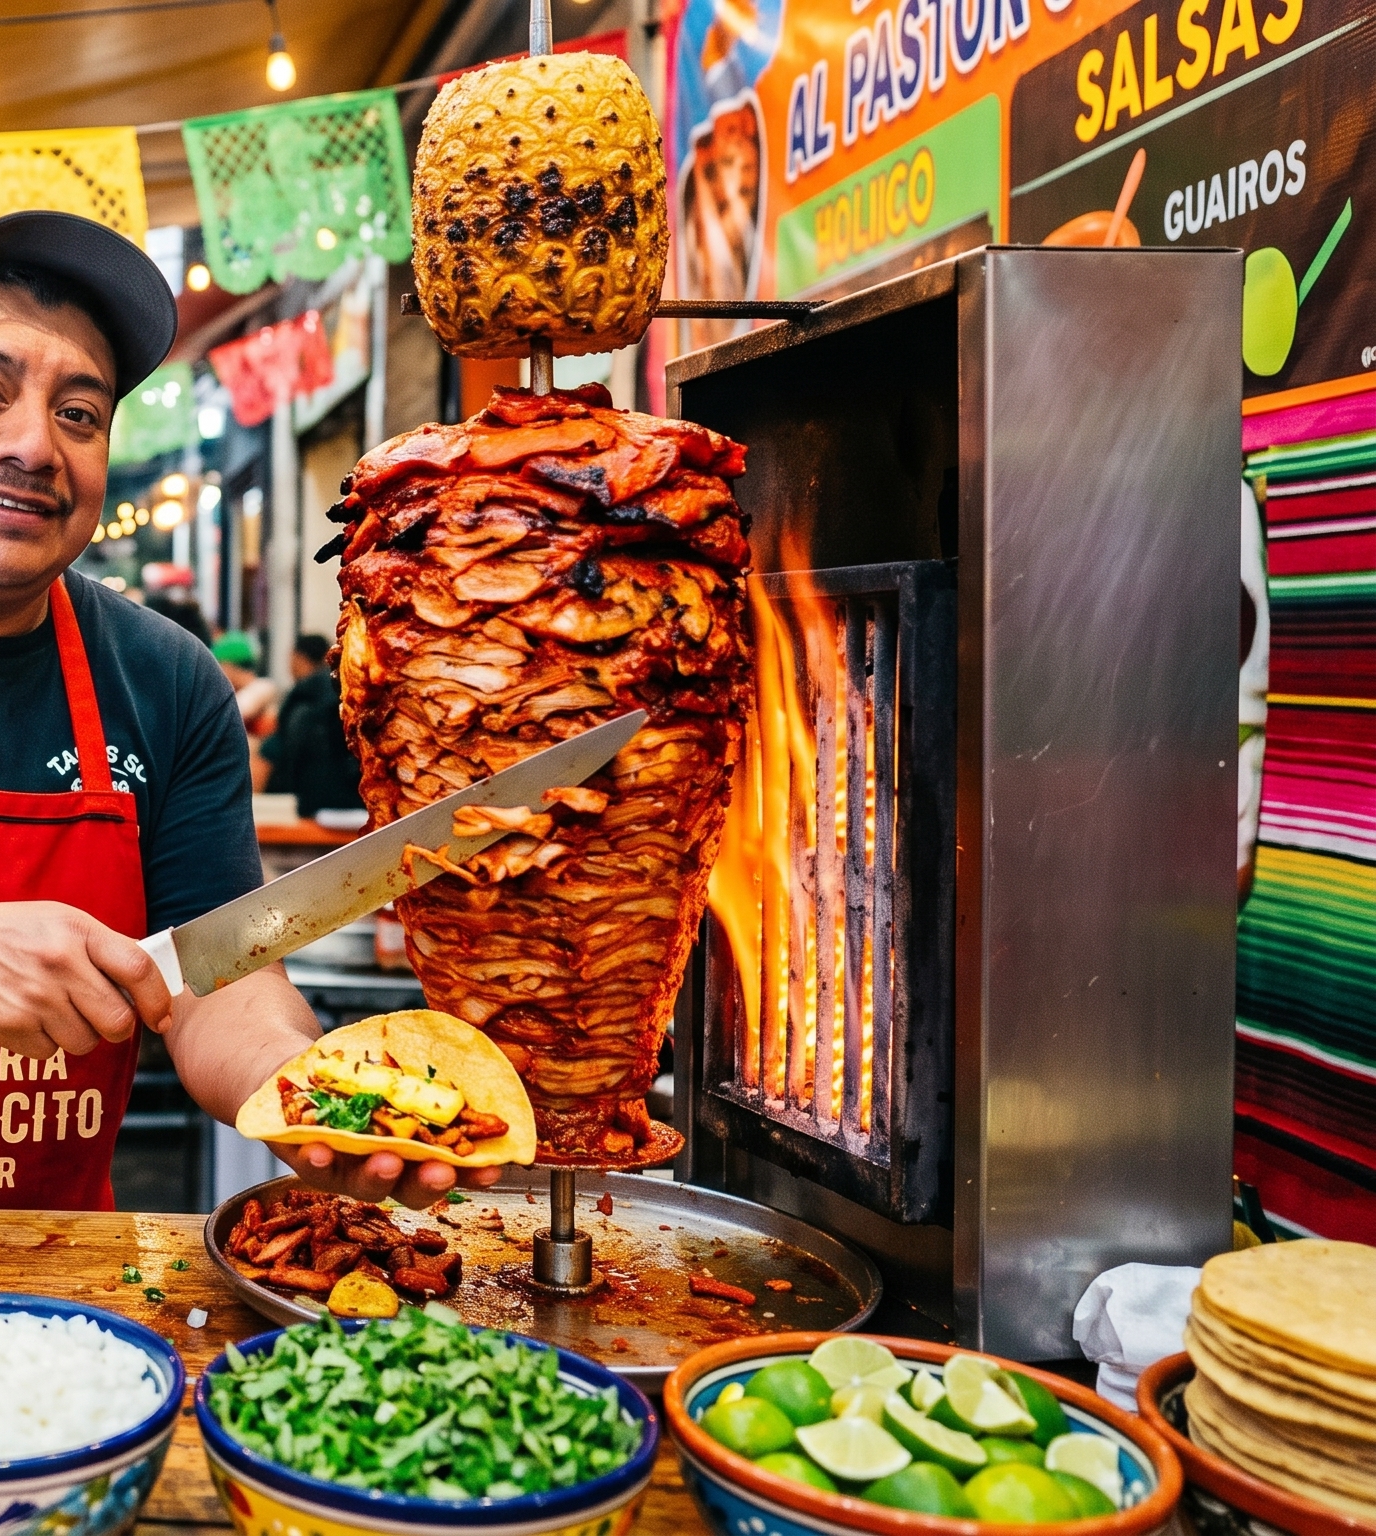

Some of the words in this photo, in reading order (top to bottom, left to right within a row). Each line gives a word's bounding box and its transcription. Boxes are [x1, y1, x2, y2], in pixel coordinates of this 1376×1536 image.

[785, 59, 835, 184] AL
[1164, 139, 1307, 242] GUAIROS
[46, 745, 119, 776] TAS
